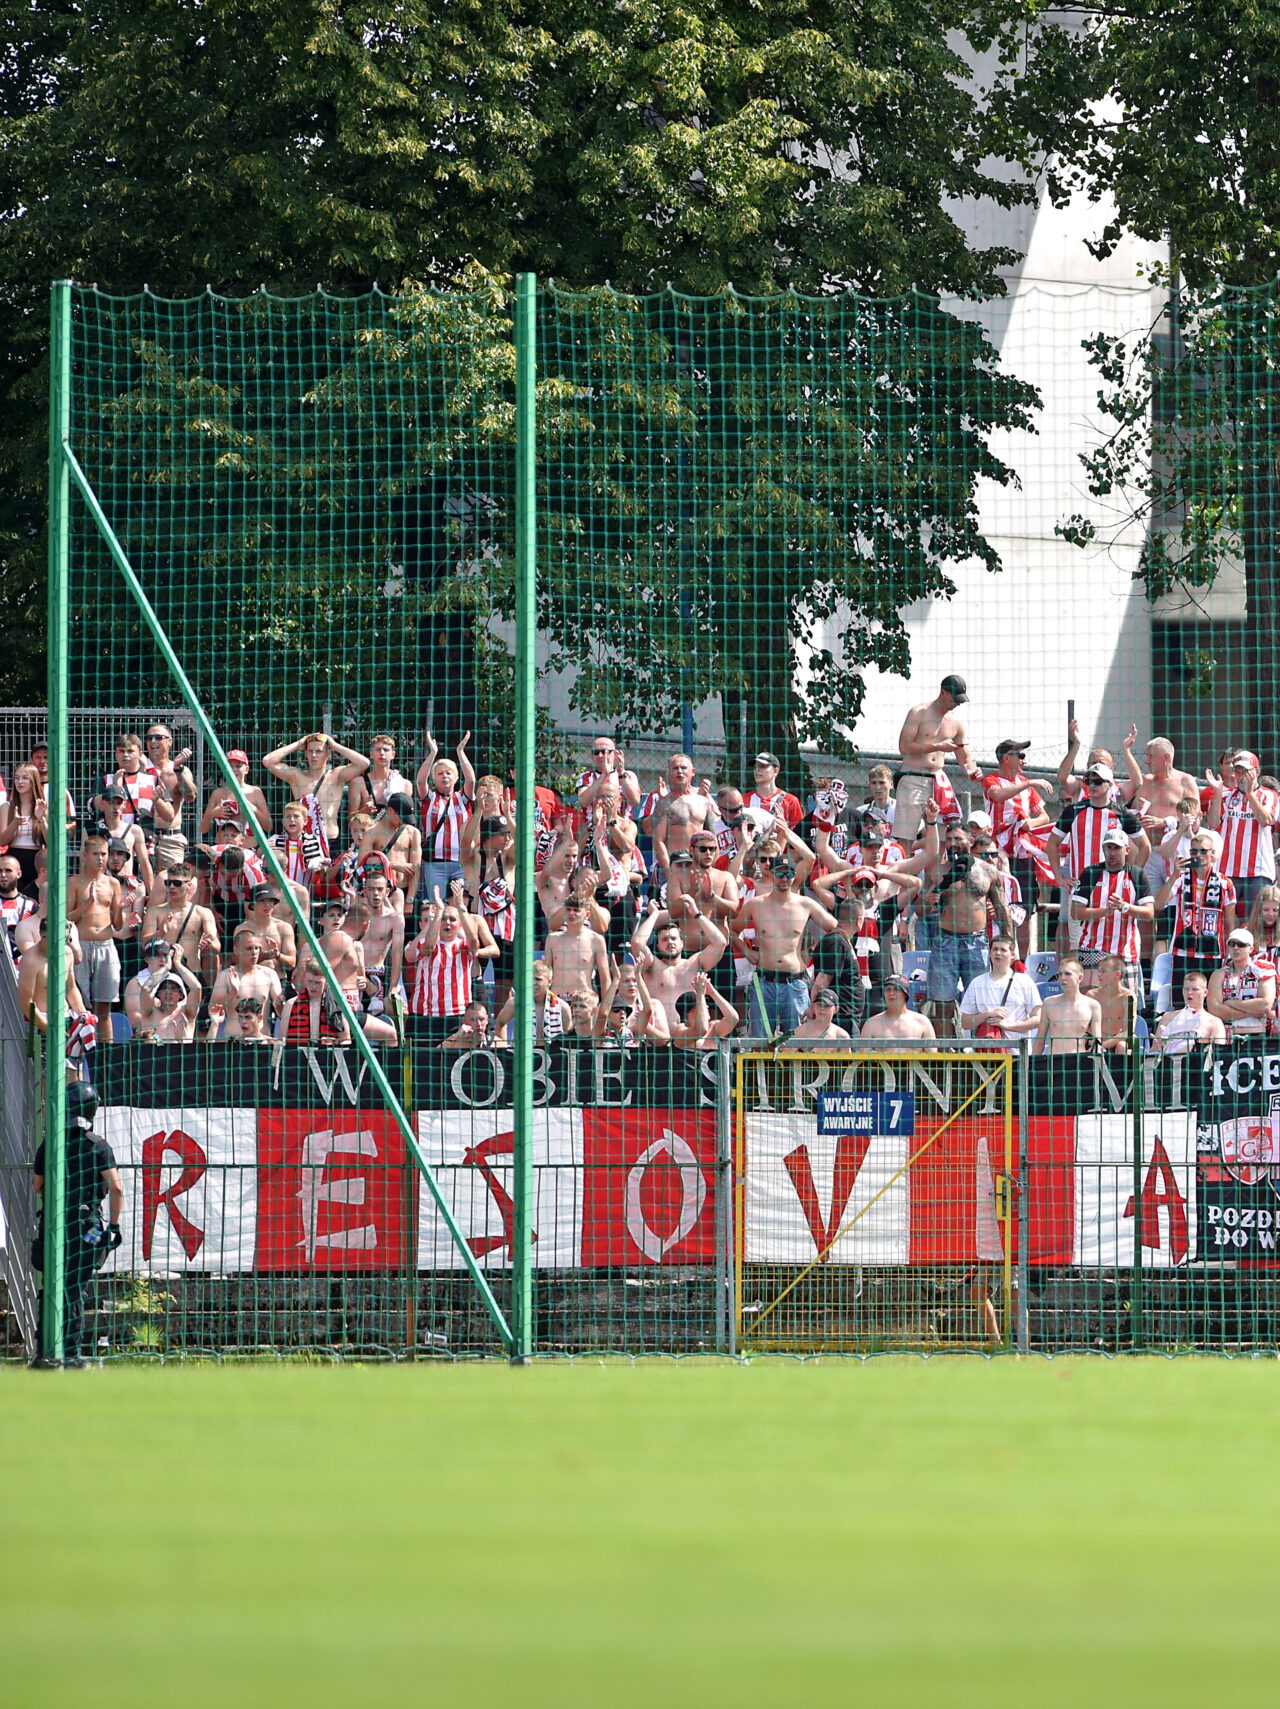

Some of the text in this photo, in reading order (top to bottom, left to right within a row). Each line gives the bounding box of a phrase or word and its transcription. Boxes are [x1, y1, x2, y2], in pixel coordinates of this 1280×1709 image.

[298, 1046, 378, 1106] W
[451, 1047, 632, 1108] OBIE
[823, 1094, 873, 1113] WYJŚCIE
[889, 1099, 903, 1129] 7
[823, 1116, 873, 1130] AWARYJNE
[1214, 1226, 1249, 1248] DO
